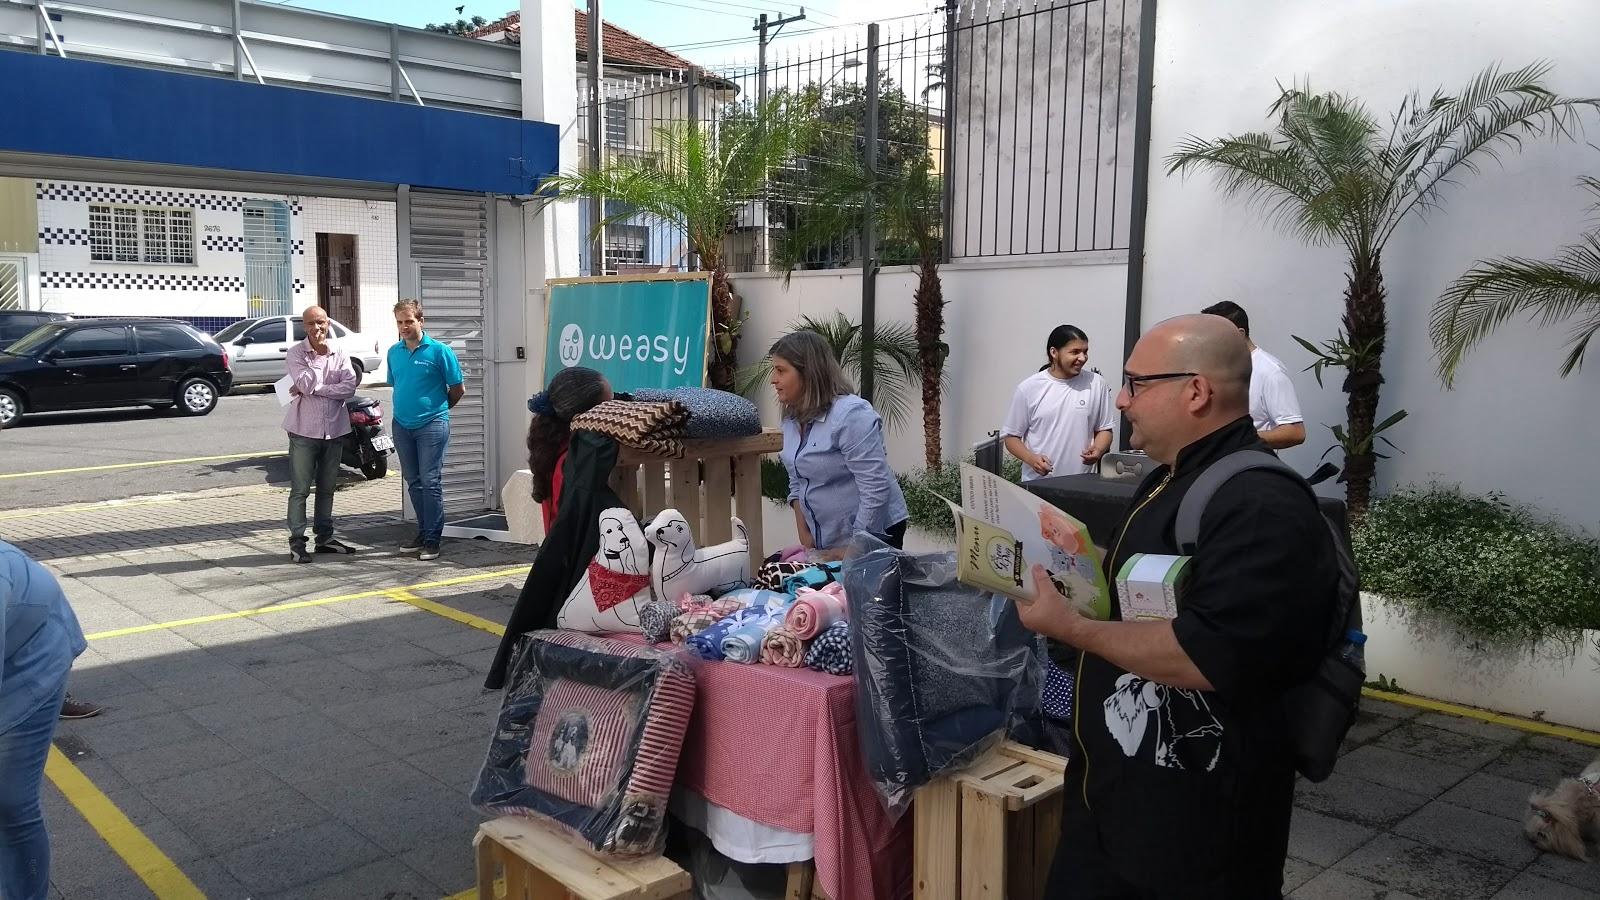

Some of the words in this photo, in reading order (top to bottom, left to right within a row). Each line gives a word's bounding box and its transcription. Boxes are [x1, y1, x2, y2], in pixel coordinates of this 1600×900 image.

[589, 334, 690, 376] weasy
[969, 524, 980, 571] Menu
[993, 543, 1008, 572] Green
